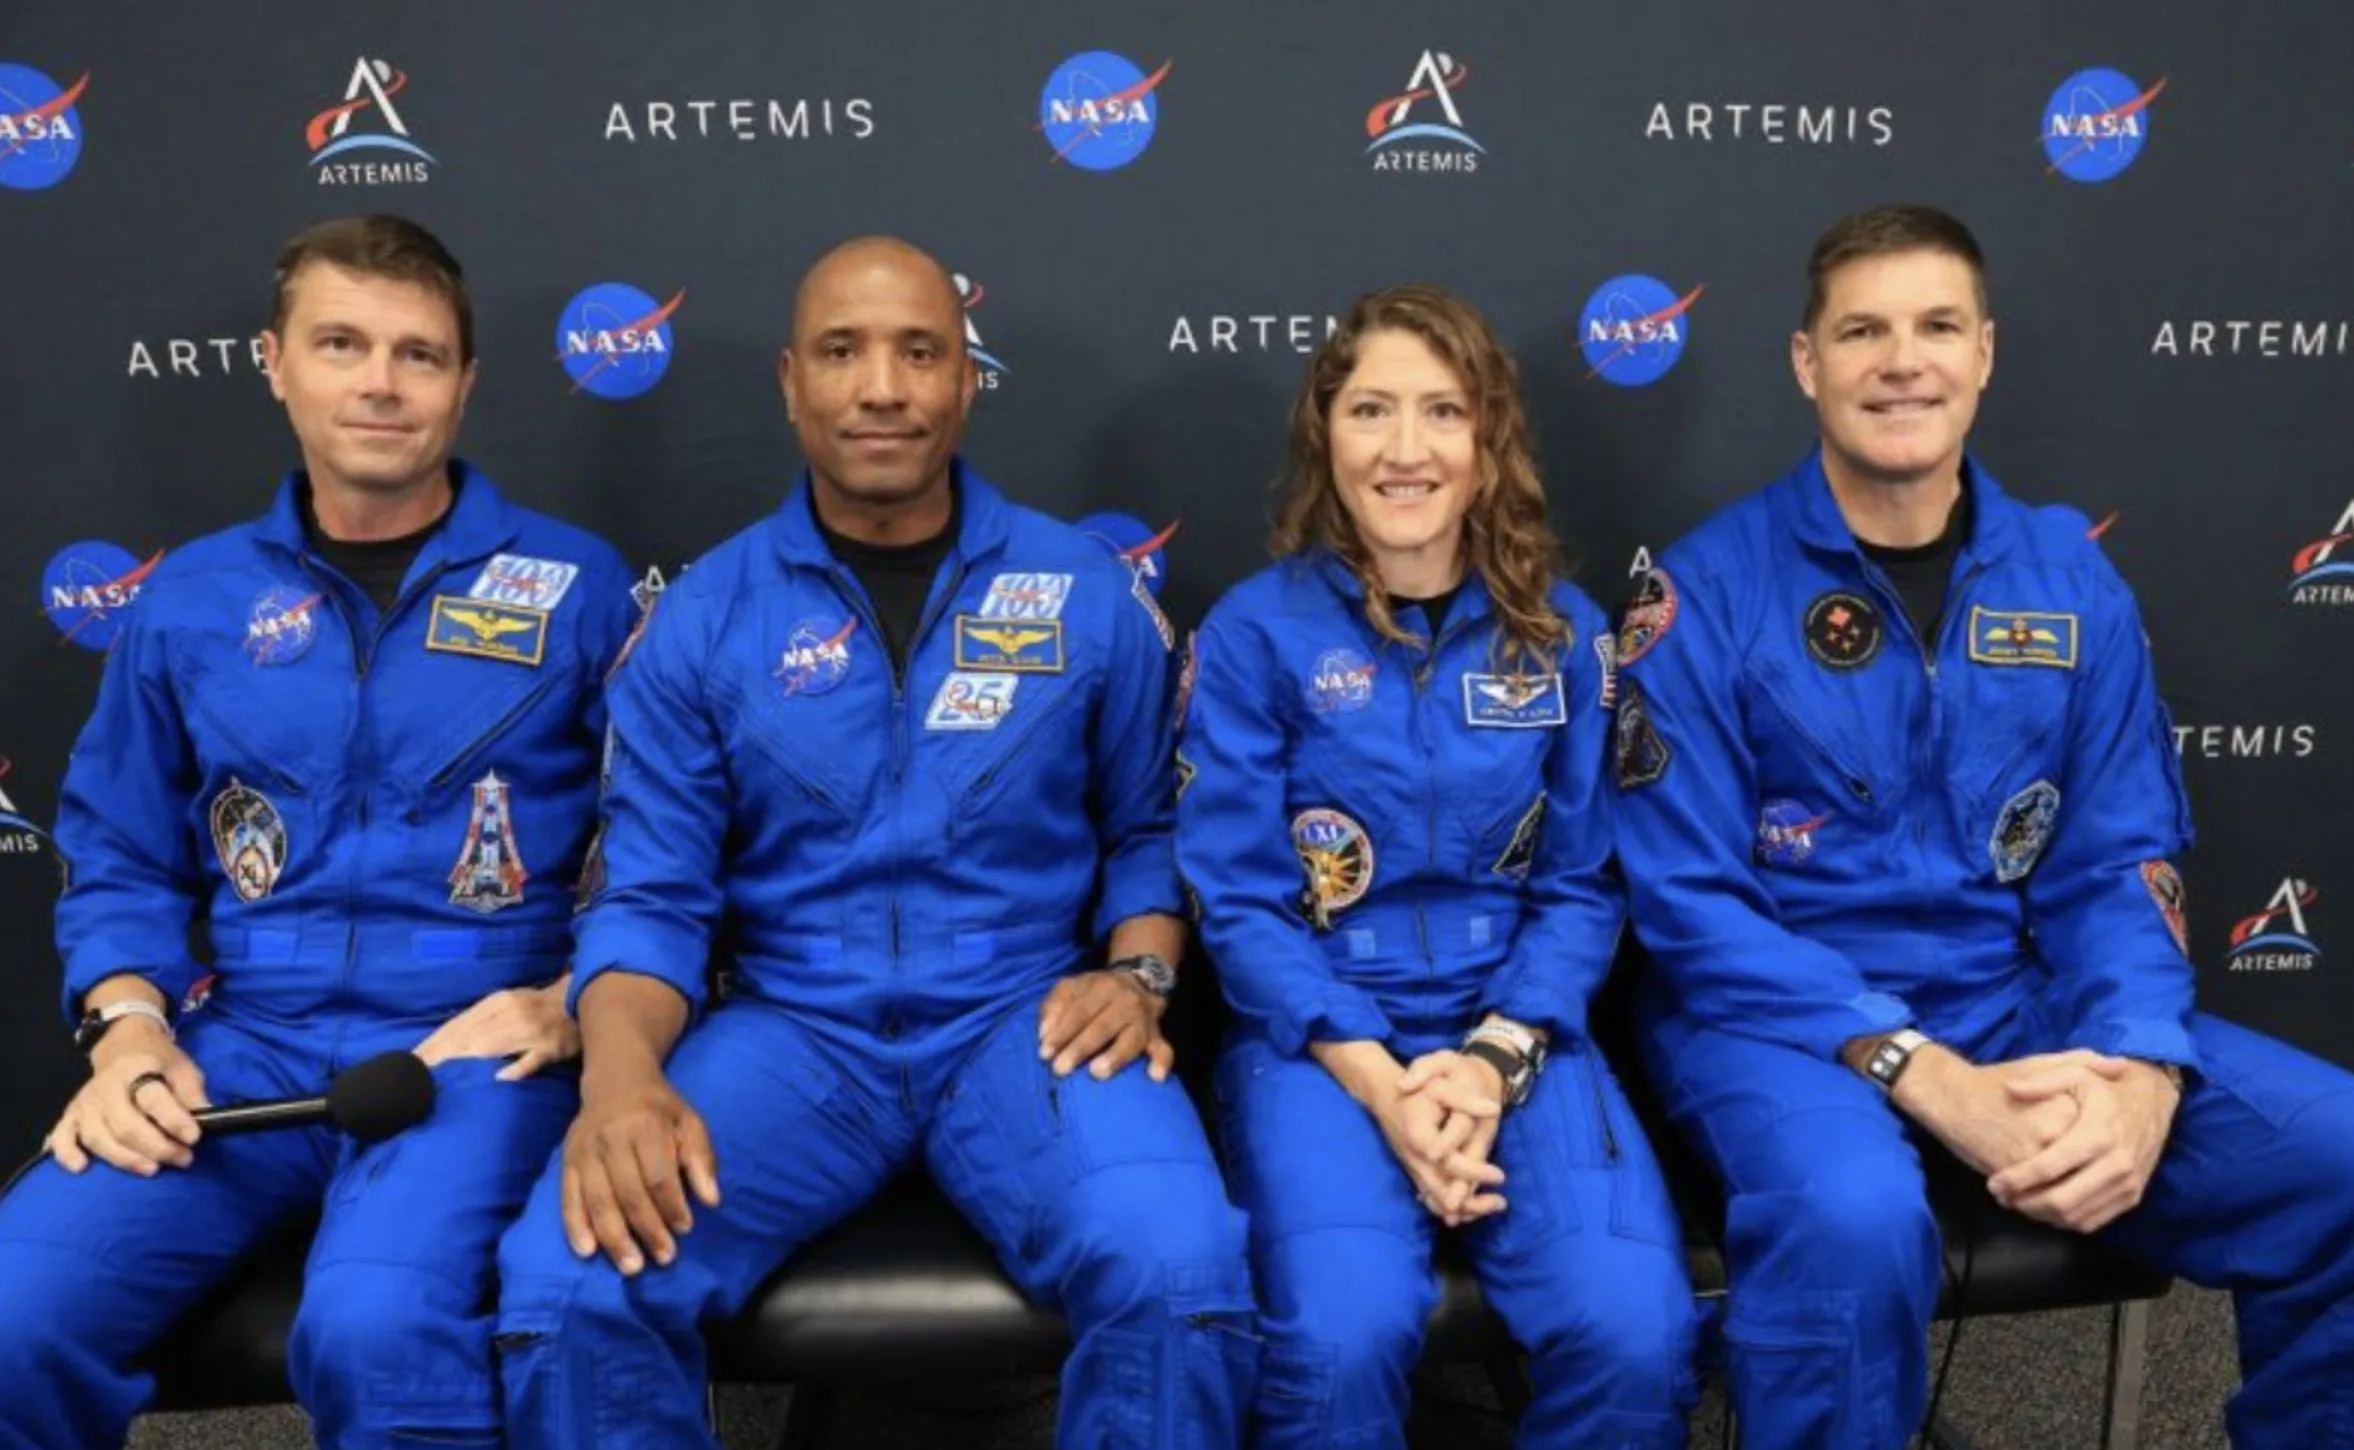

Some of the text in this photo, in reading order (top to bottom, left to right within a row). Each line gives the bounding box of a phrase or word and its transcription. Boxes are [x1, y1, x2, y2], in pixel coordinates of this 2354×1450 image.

[605, 98, 873, 140] ARTEMIS
[1050, 98, 1150, 124] NASA
[1645, 102, 1893, 146] ARTEMIS
[0, 113, 76, 140] ASA
[2048, 113, 2141, 138] NASA
[318, 161, 429, 185] ARTEMIS
[1373, 150, 1478, 173] ARTEMIS
[566, 329, 667, 354] NASA
[1169, 315, 1338, 353] ARTE
[1588, 317, 1679, 343] NASA
[2151, 320, 2348, 356] ARTEMI
[128, 338, 269, 378] ARTE
[2292, 585, 2354, 605] ARTEM
[248, 611, 311, 640] NASA
[782, 643, 849, 669] NASA
[1314, 672, 1370, 692] NASA
[2172, 724, 2316, 758] TEMIS
[2229, 953, 2314, 972] ARTEMIS
